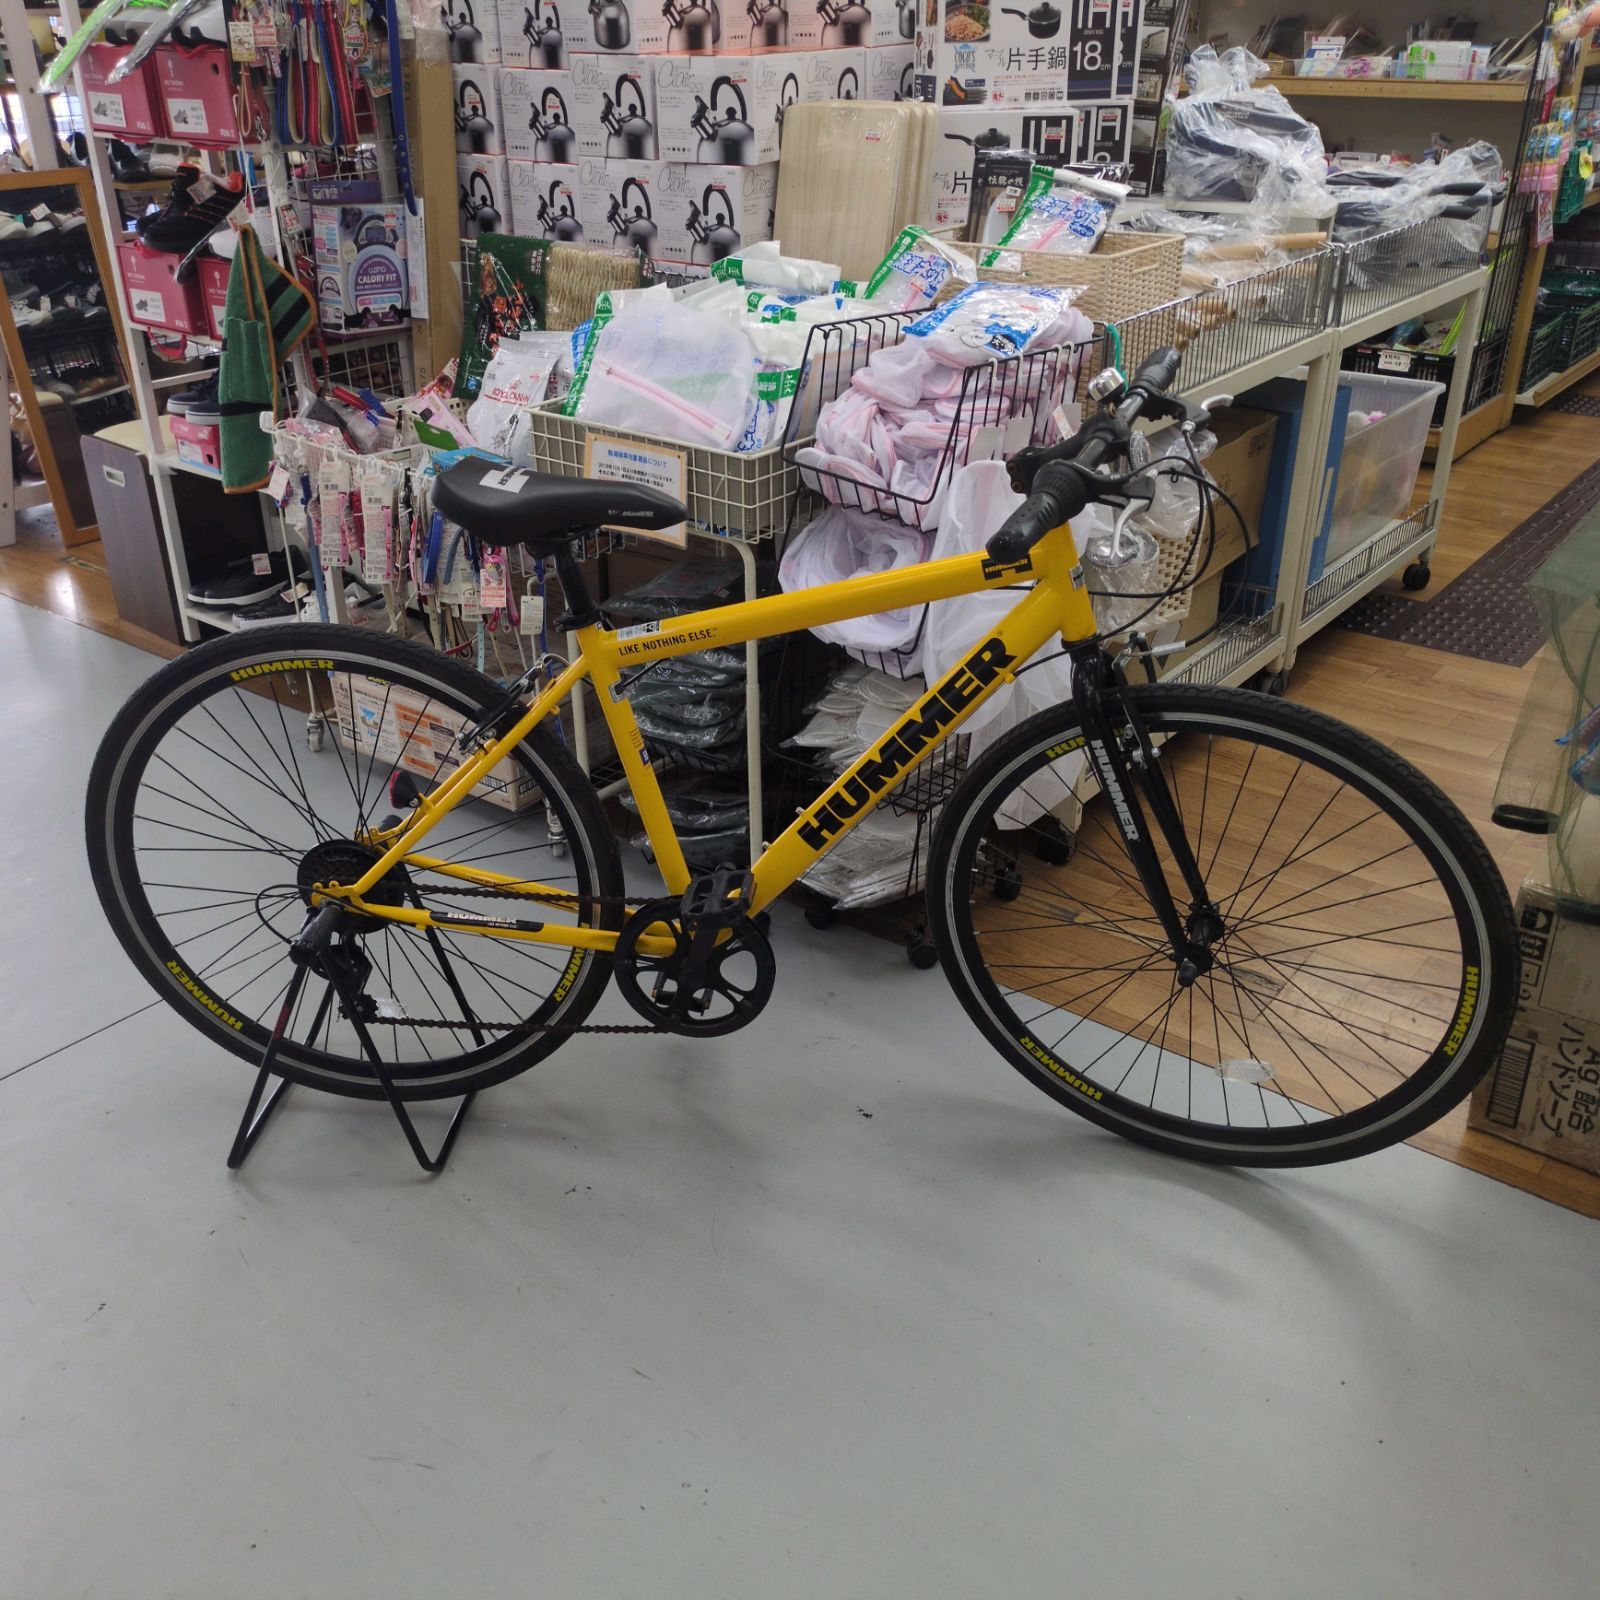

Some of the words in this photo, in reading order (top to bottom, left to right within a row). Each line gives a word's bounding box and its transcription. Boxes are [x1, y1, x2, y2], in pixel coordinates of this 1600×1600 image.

[1006, 46, 1067, 72] 片手鍋
[357, 275, 385, 284] CALORY
[386, 273, 397, 281] FIT
[229, 659, 335, 682] HUMMER
[619, 644, 641, 656] LIKE
[643, 635, 687, 652] NOTHING
[797, 637, 1018, 851] HUMMER
[1090, 739, 1140, 841] HUMMER
[447, 912, 517, 925] HUMMER
[165, 960, 244, 1031] HUMMER
[1442, 966, 1479, 1056] HUMMER
[1020, 1036, 1103, 1101] HUMMER
[1540, 1022, 1586, 1139] ハンドソープ
